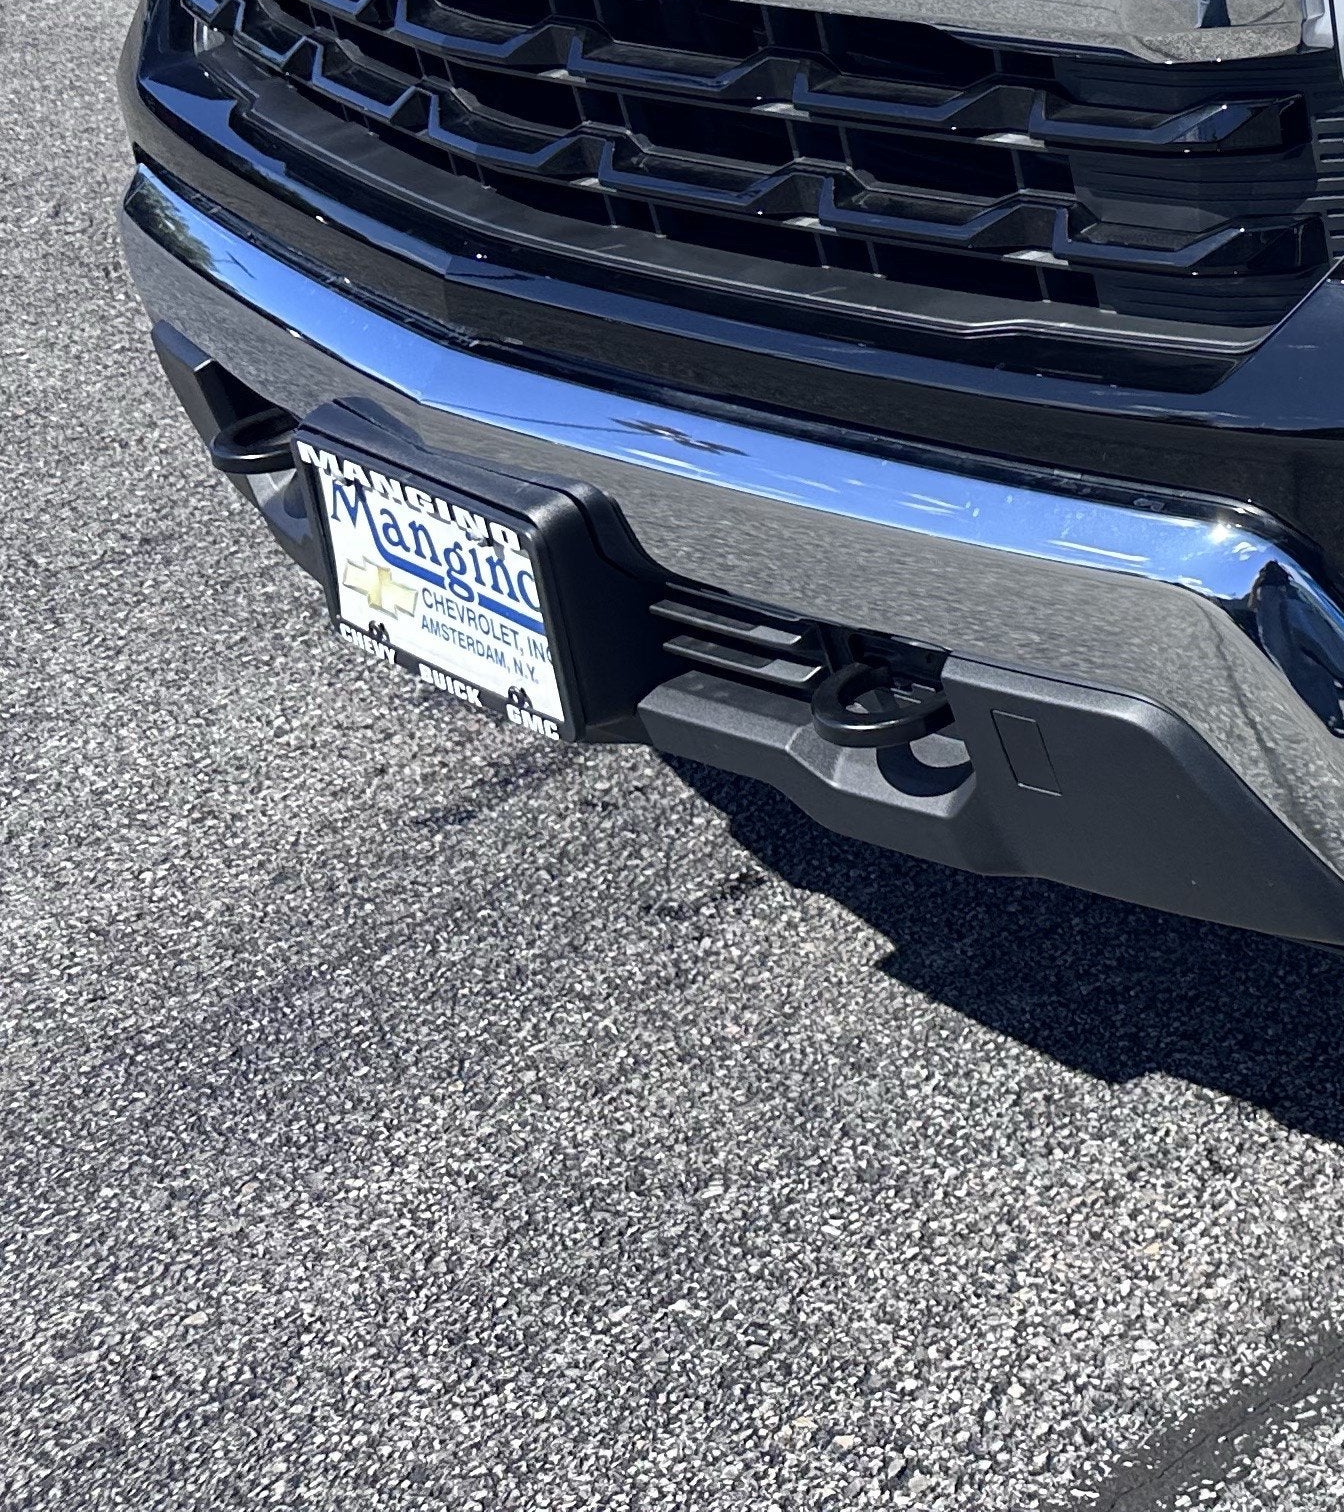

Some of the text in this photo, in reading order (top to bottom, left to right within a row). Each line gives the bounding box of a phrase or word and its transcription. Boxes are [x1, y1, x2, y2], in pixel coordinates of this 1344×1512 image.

[296, 439, 523, 552] MANGINO
[421, 586, 525, 657] CHEVROLET,
[339, 622, 560, 742] CHEVY BUICK GMC
